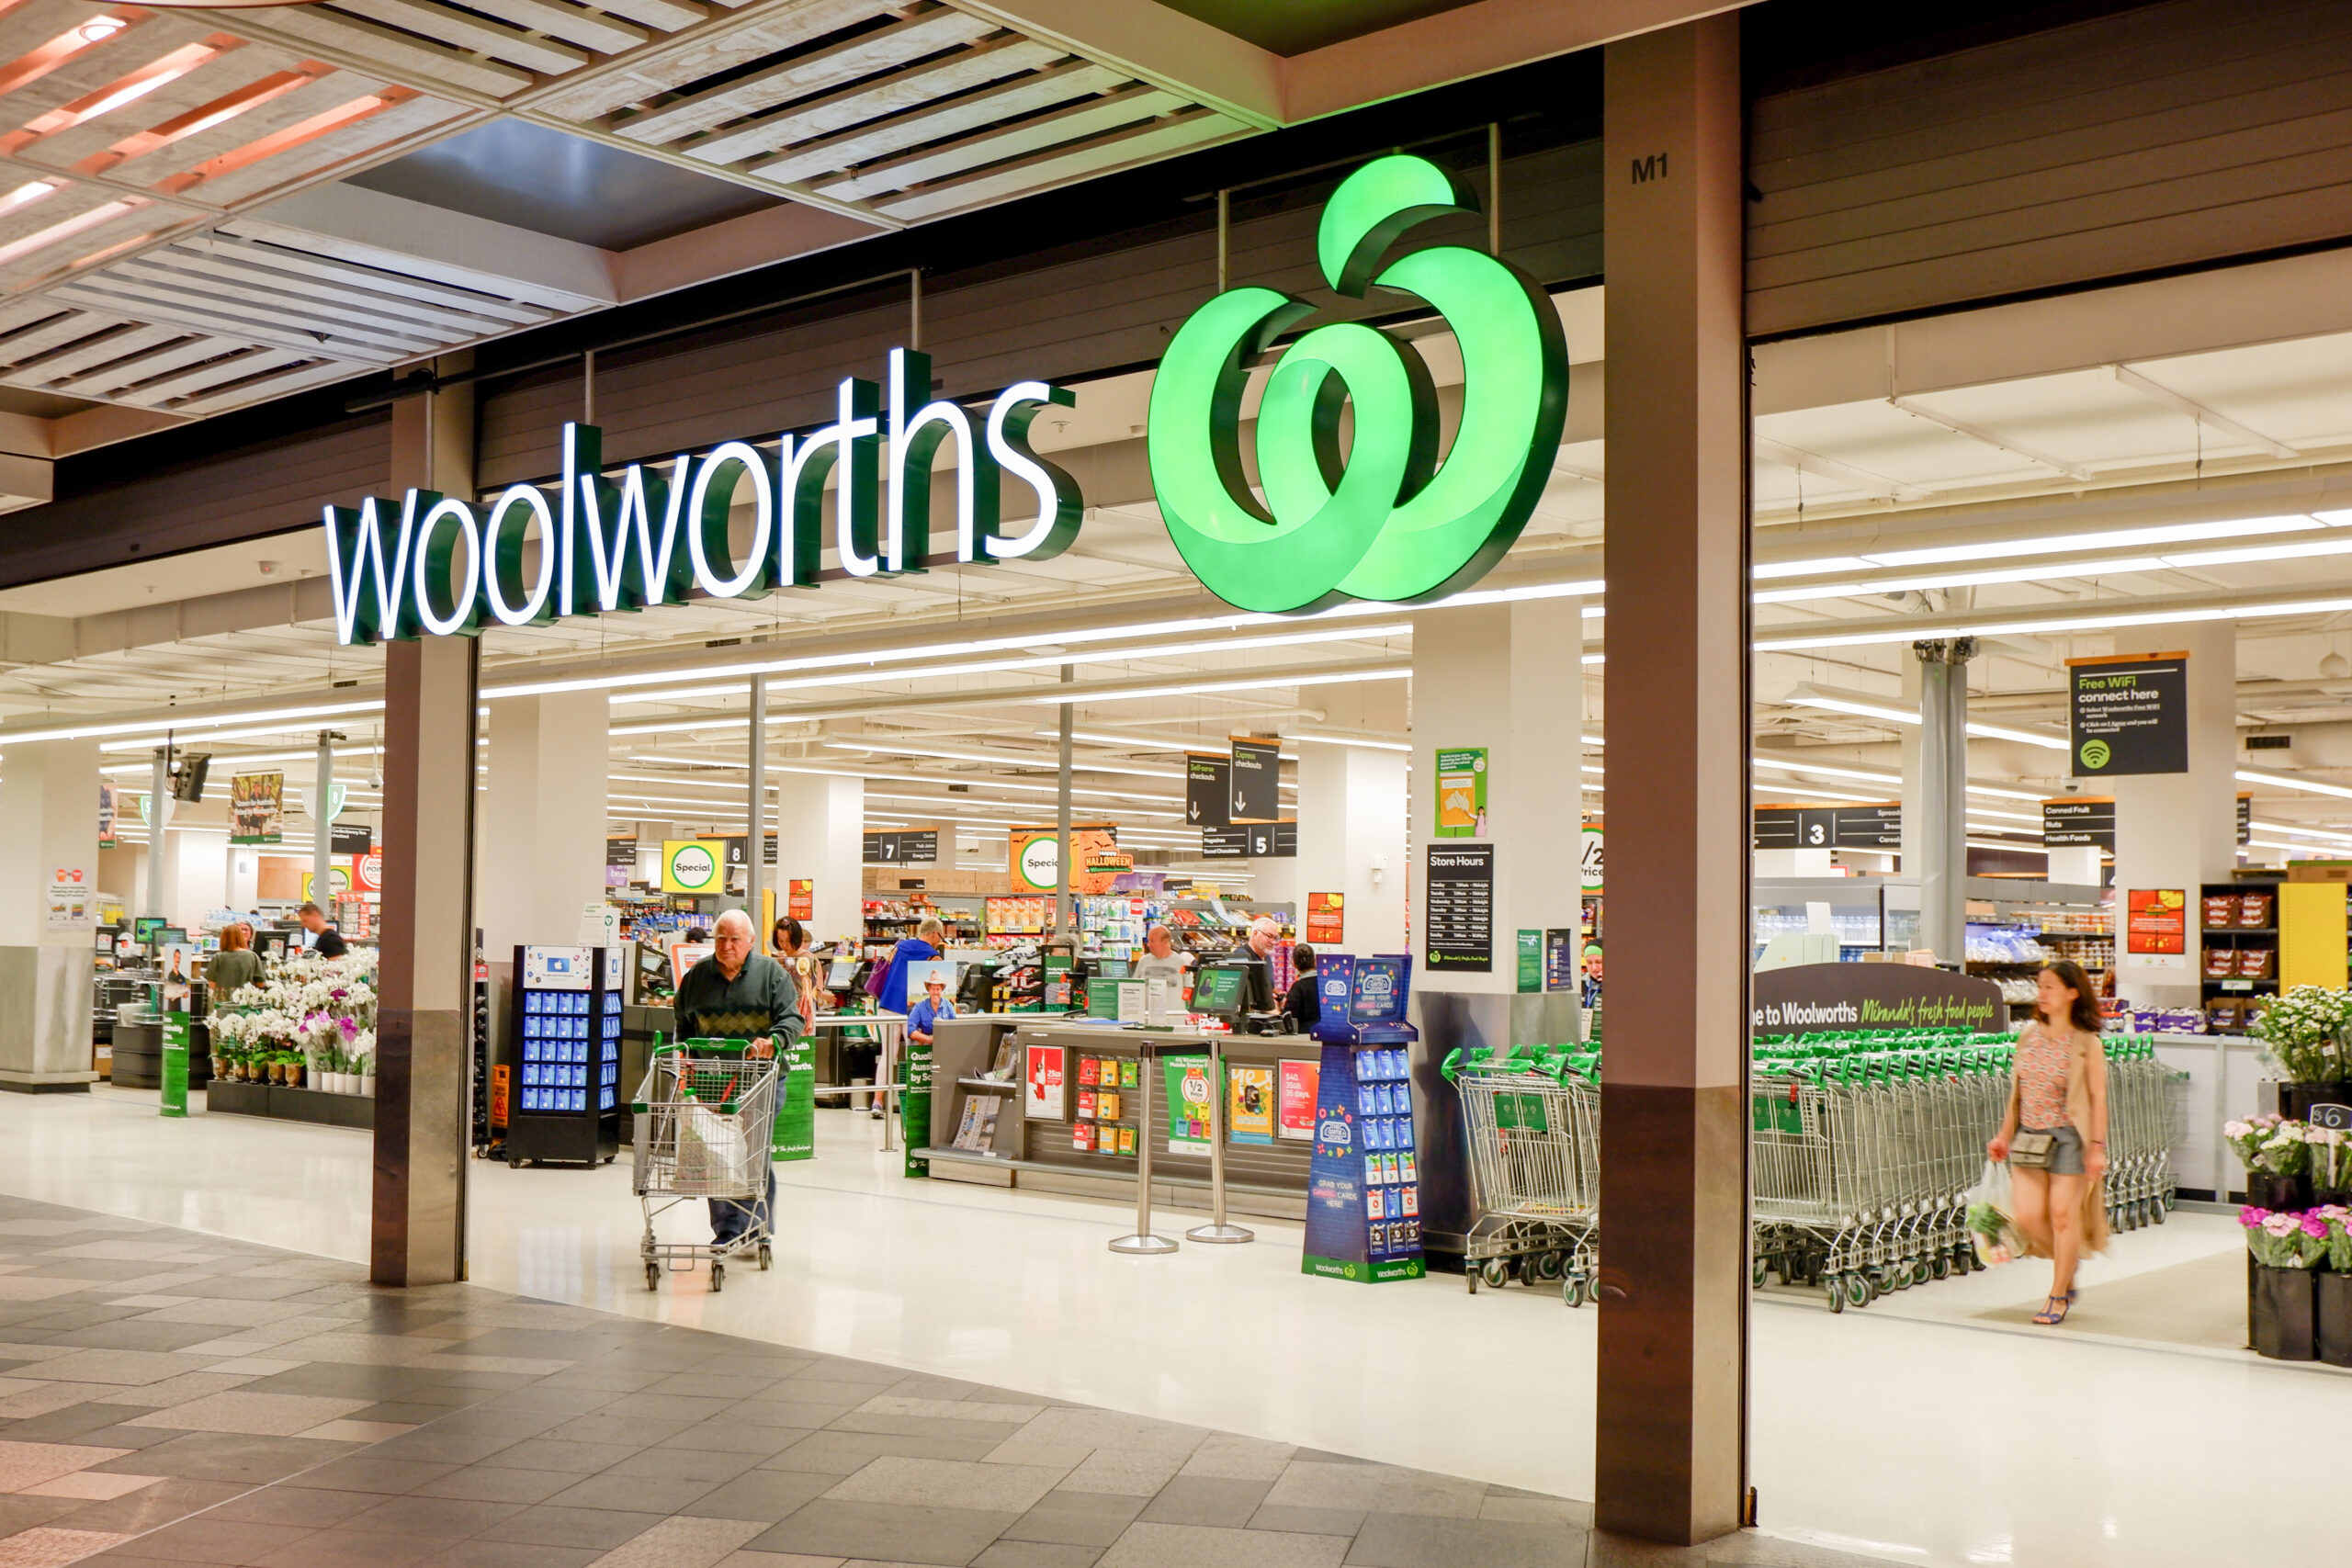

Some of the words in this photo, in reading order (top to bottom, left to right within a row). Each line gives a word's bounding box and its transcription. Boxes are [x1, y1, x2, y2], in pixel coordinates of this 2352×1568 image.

[1632, 152, 1667, 184] M1
[323, 347, 1073, 646] woolworths
[2079, 679, 2105, 689] Free
[2108, 675, 2136, 687] WiFi
[2078, 691, 2129, 703] connect
[2131, 689, 2159, 700] here
[1235, 750, 1256, 760] Express
[1235, 760, 1261, 769] checkouts
[1190, 773, 1215, 781] checkouts
[1809, 824, 1825, 844] 3
[1255, 837, 1267, 854] 5
[732, 847, 741, 862] 8
[886, 844, 894, 859] 7
[1582, 840, 1603, 865] /2
[1027, 858, 1058, 868] Specia
[1086, 856, 1131, 867] HALLOWEEN
[1430, 855, 1455, 866] Store
[1456, 855, 1484, 866] Hours
[675, 863, 710, 873] Special
[1581, 866, 1603, 877] rice
[1766, 1002, 1781, 1025] to
[1782, 1000, 1858, 1026] Woolworths
[1860, 997, 1916, 1026] Miranda's
[1917, 996, 1943, 1028] fresh
[1944, 994, 1967, 1027] food
[1966, 997, 1994, 1028] people
[796, 1042, 809, 1050] with
[790, 1053, 799, 1062] by
[910, 1052, 933, 1061] Quali
[789, 1063, 813, 1071] worths.
[910, 1063, 933, 1072] Aussi
[910, 1073, 922, 1083] by
[1189, 1080, 1203, 1092] 1/2
[1318, 1179, 1335, 1189] GRAB
[1336, 1181, 1353, 1190] YOUR
[1337, 1190, 1357, 1201] CARDS
[1326, 1200, 1343, 1208] HERE!
[1315, 1263, 1343, 1275] woolworths
[1377, 1268, 1407, 1278] woolworths
